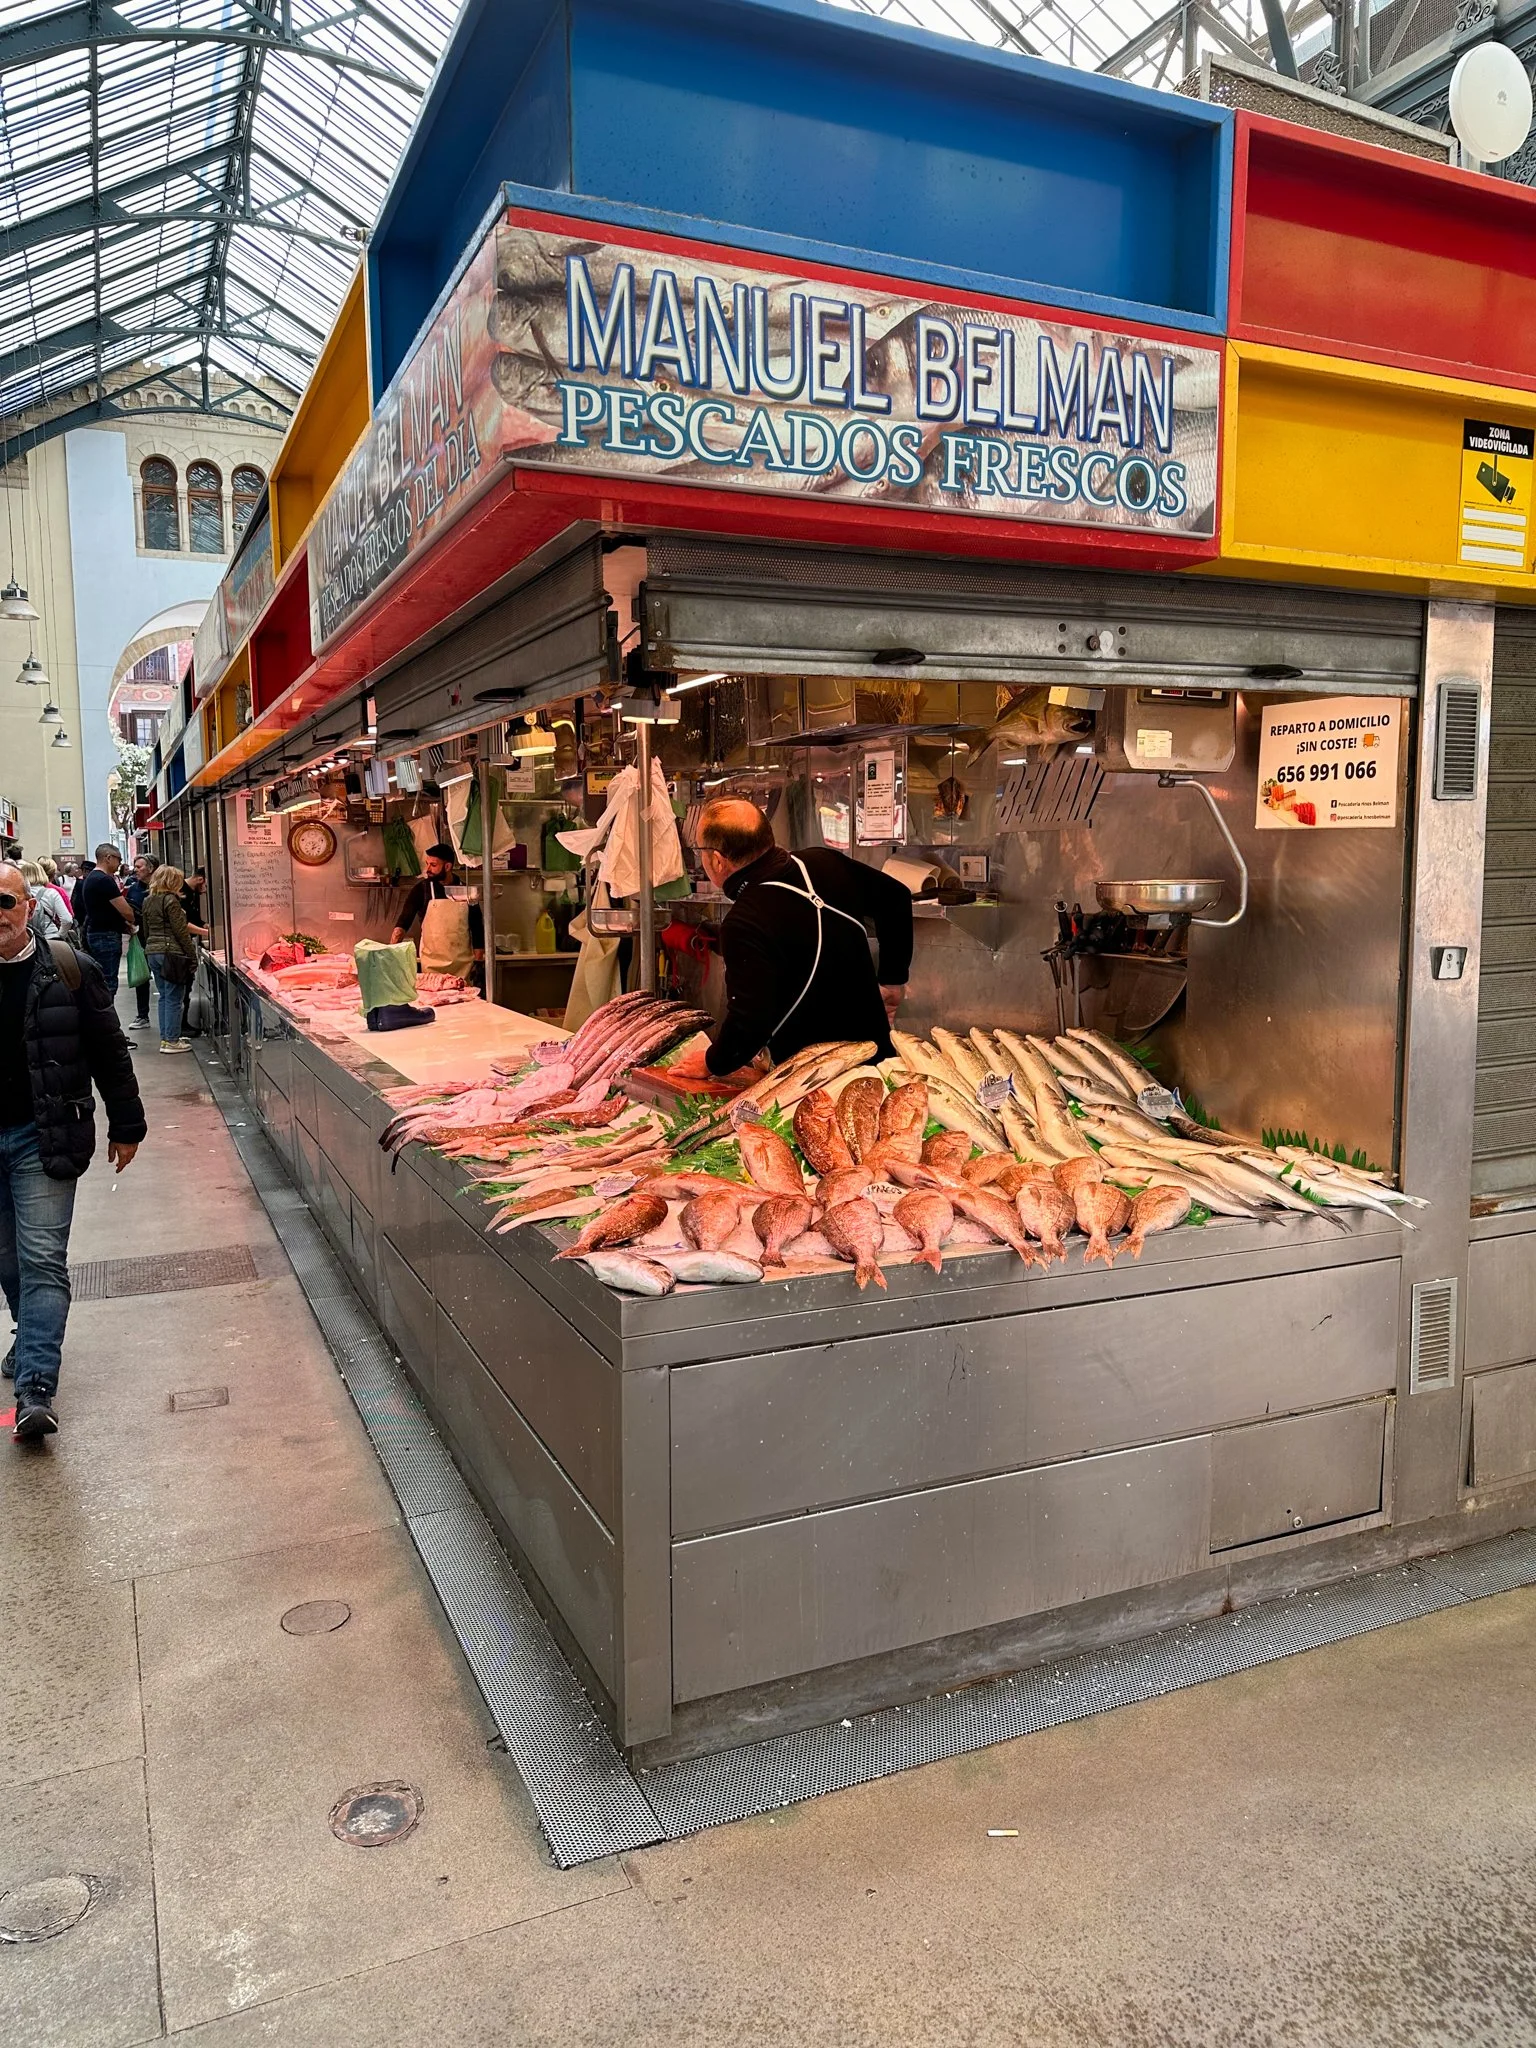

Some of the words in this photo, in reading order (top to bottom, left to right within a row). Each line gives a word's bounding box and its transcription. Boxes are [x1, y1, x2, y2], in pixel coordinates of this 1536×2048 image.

[566, 255, 892, 413] MANUEL
[915, 313, 1175, 453] BELMAN
[321, 457, 375, 575] MANUEL
[377, 304, 464, 507] BELMAN
[1488, 426, 1511, 441] ZONA
[557, 381, 922, 488] PESCADOS
[941, 430, 1188, 517] FRESCOS
[1469, 436, 1529, 456] VIDEOVIGILADA
[321, 550, 365, 627] PESCADOS
[364, 487, 412, 583] FRESCOS
[413, 451, 444, 529] DEL
[1270, 721, 1316, 737] REPARTO
[1318, 720, 1326, 732] A
[1329, 714, 1391, 731] DOMICILIO
[1296, 740, 1318, 755] ¡SIN
[1320, 737, 1357, 751] COSTE!
[1276, 764, 1306, 784] 656
[1309, 762, 1339, 782] 991
[1344, 760, 1377, 780] 066
